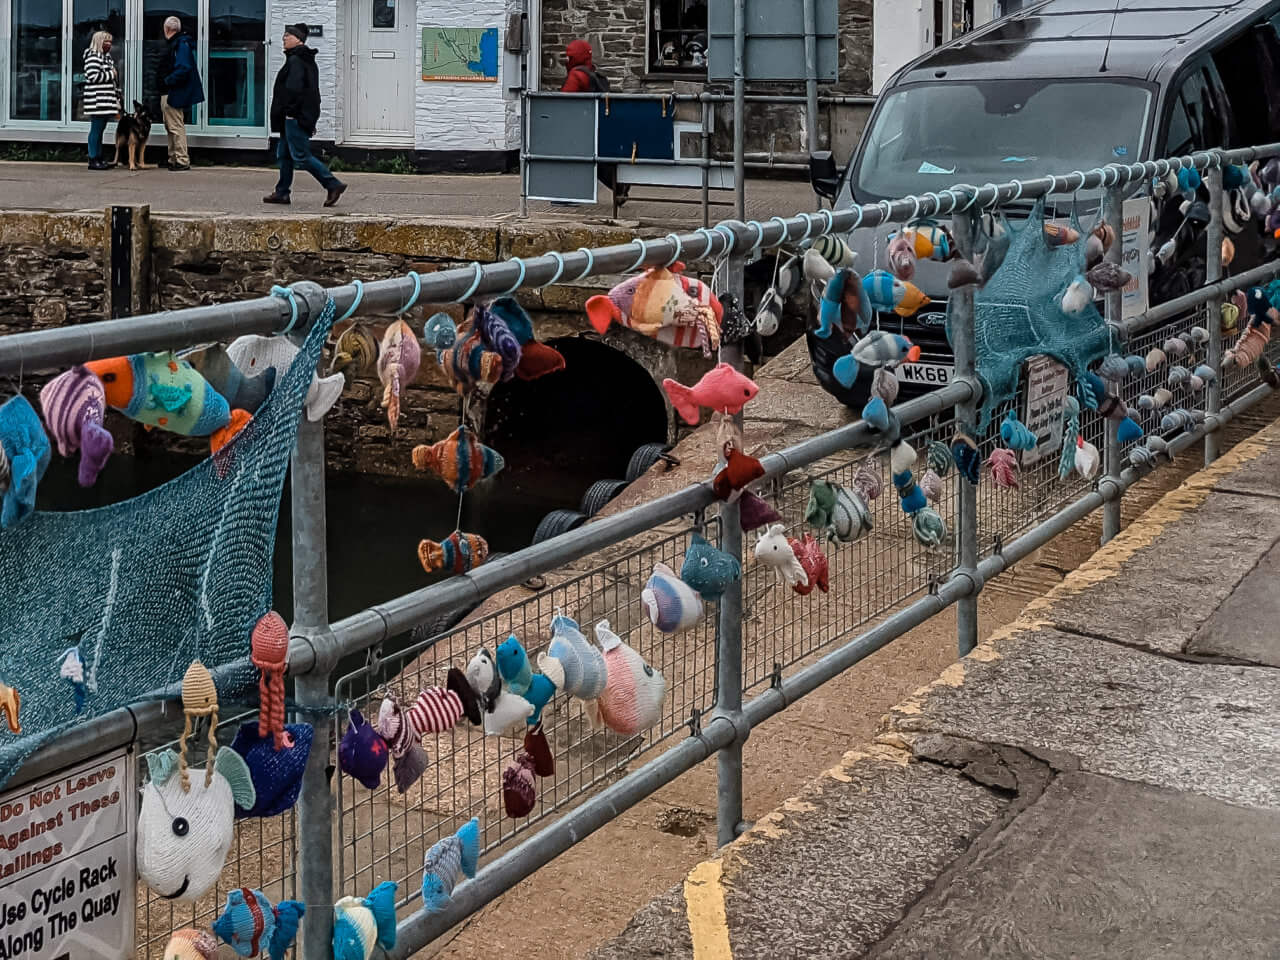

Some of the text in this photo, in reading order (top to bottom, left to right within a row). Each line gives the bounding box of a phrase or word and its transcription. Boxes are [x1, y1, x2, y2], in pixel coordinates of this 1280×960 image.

[903, 365, 948, 382] WK68
[0, 803, 24, 822] Do
[29, 784, 61, 810] Not
[66, 766, 116, 794] Leave
[68, 791, 120, 821] These
[31, 877, 75, 916] Cycle
[79, 856, 117, 893] Rack
[48, 909, 77, 939] The
[81, 890, 121, 923] Quay
